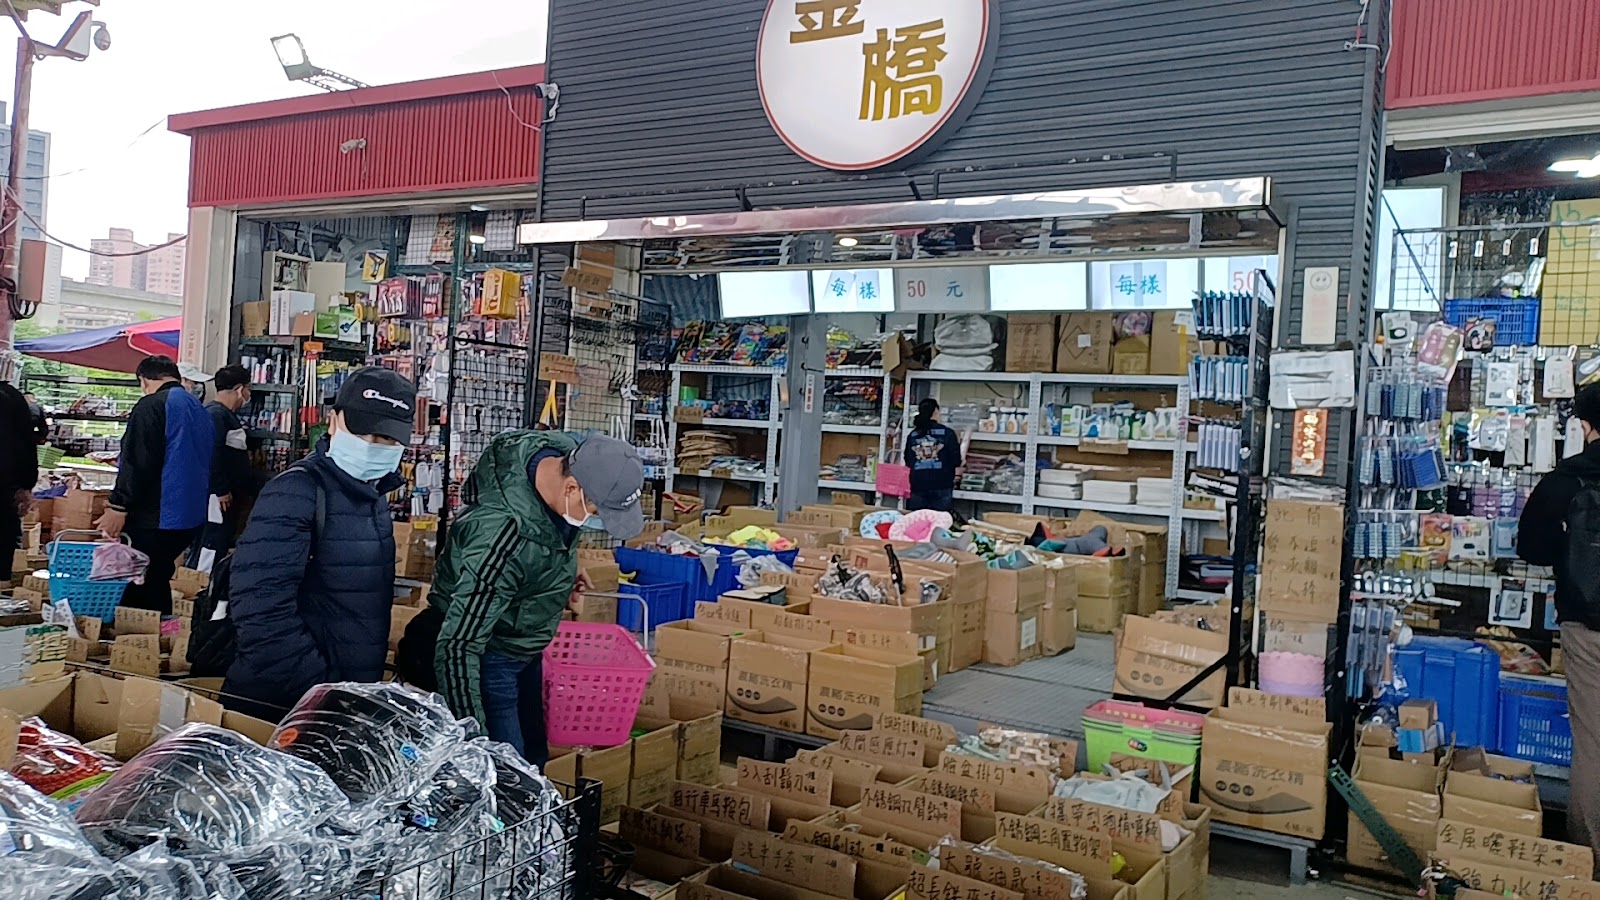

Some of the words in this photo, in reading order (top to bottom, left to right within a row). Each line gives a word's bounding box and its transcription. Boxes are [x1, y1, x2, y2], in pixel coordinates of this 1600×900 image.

[829, 276, 879, 300] 每樣
[906, 279, 927, 298] 50
[945, 279, 964, 298] 元
[1114, 273, 1162, 296] 每樣
